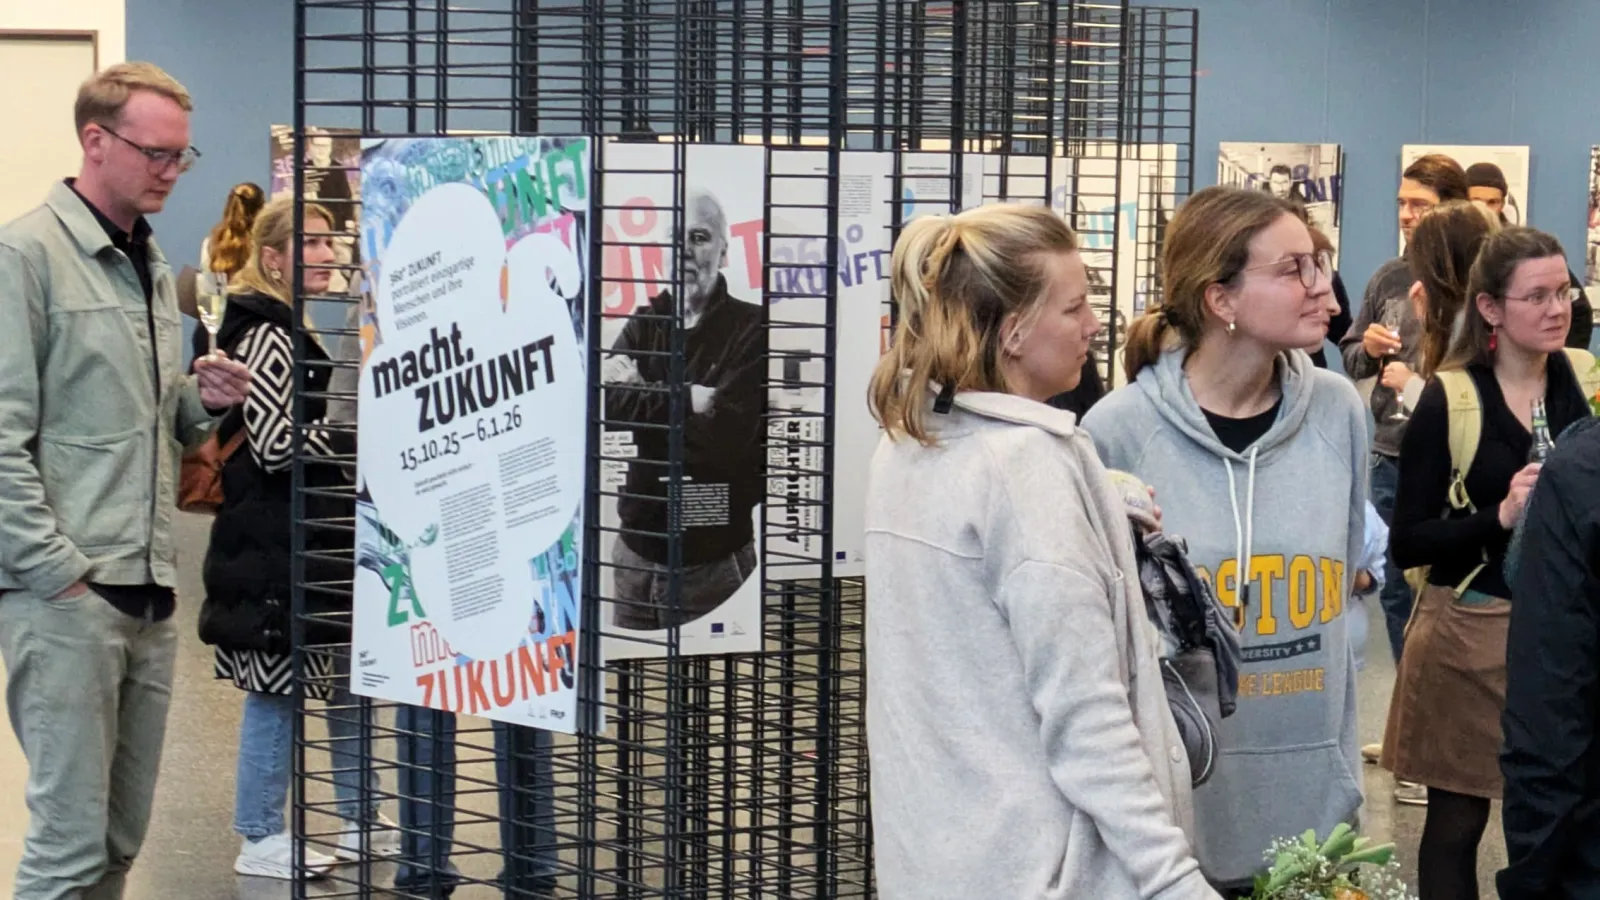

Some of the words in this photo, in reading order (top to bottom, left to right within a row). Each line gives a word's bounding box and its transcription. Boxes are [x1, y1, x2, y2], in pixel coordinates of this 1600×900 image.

[408, 251, 441, 276] ZUKUNFT
[394, 293, 431, 314] Menschen
[432, 282, 447, 299] und
[372, 322, 474, 398] macht.
[415, 334, 555, 433] ZUKUNFT
[1196, 553, 1345, 635] STON
[1262, 668, 1324, 696] LEAGUE
